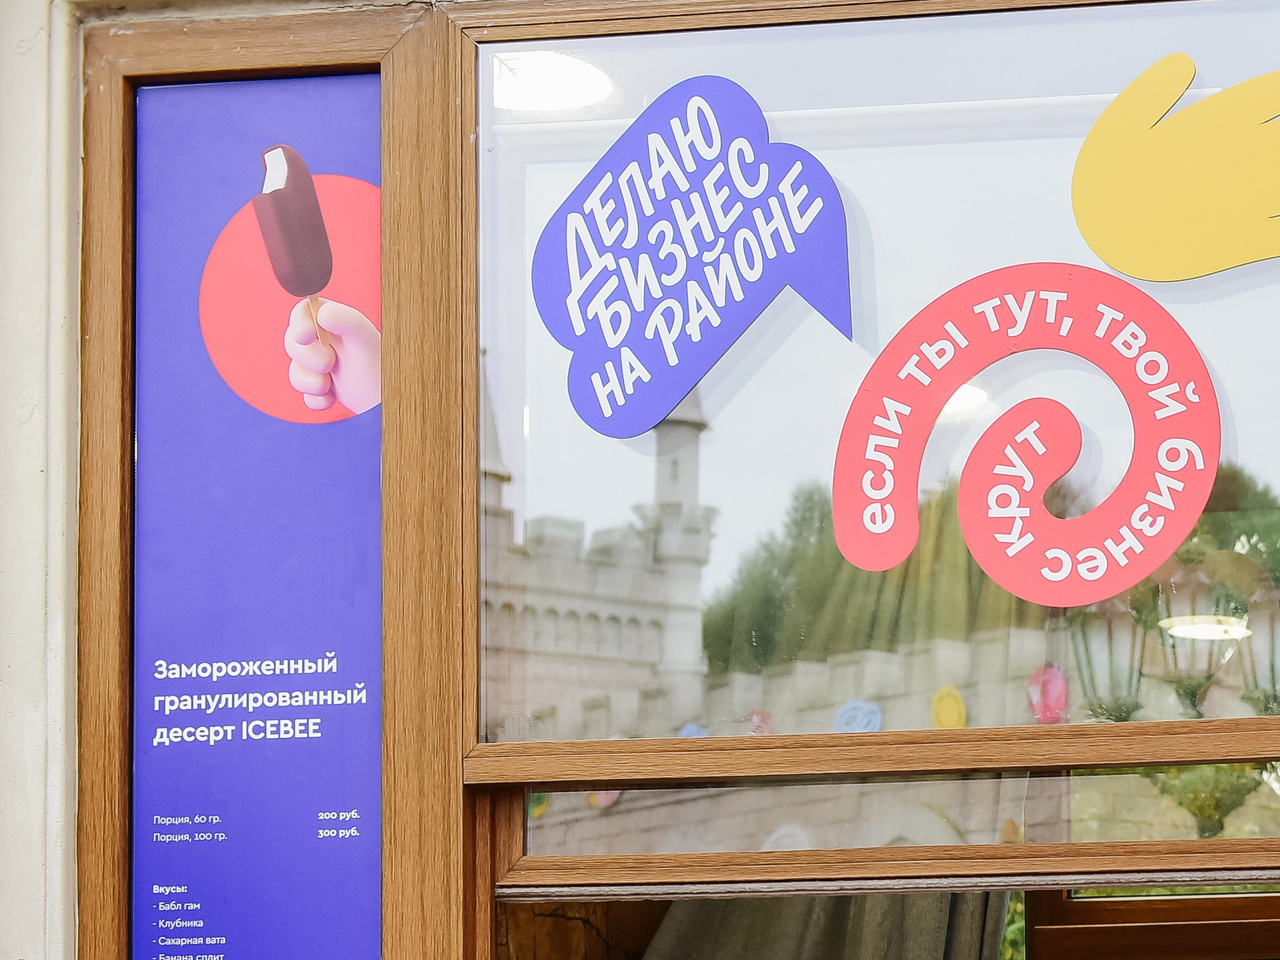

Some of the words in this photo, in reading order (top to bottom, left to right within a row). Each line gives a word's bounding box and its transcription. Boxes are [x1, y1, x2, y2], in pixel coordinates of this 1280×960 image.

[566, 95, 722, 337] ДЕЛАЮ
[586, 137, 769, 349] БИЗНЕС
[590, 346, 652, 418] НА
[644, 160, 824, 367] РАЙОНЕ
[973, 290, 1074, 337] тут,
[898, 321, 970, 386] ты
[1094, 303, 1201, 420] твой
[862, 396, 912, 534] если
[987, 420, 1048, 558] крут
[1040, 437, 1206, 583] бизнес
[153, 651, 338, 681] Замороженный
[153, 683, 367, 715] гранулированный
[153, 724, 236, 746] десерт
[241, 718, 322, 740] ICEBEE
[153, 815, 192, 826] Порция,
[194, 814, 207, 824] 60
[208, 815, 222, 825] гр.
[317, 811, 337, 820] 200
[339, 809, 361, 821] руб.
[153, 832, 192, 843] Порция,
[194, 832, 213, 841] 100
[214, 832, 228, 842] гр.
[317, 828, 337, 838] 300
[339, 826, 360, 838] руб.
[153, 885, 188, 895] Вкусы:
[158, 901, 182, 911] Бабл
[184, 902, 201, 910] гам
[158, 919, 204, 929] Клубника
[158, 936, 204, 946] Сахарная
[205, 936, 226, 945] вата
